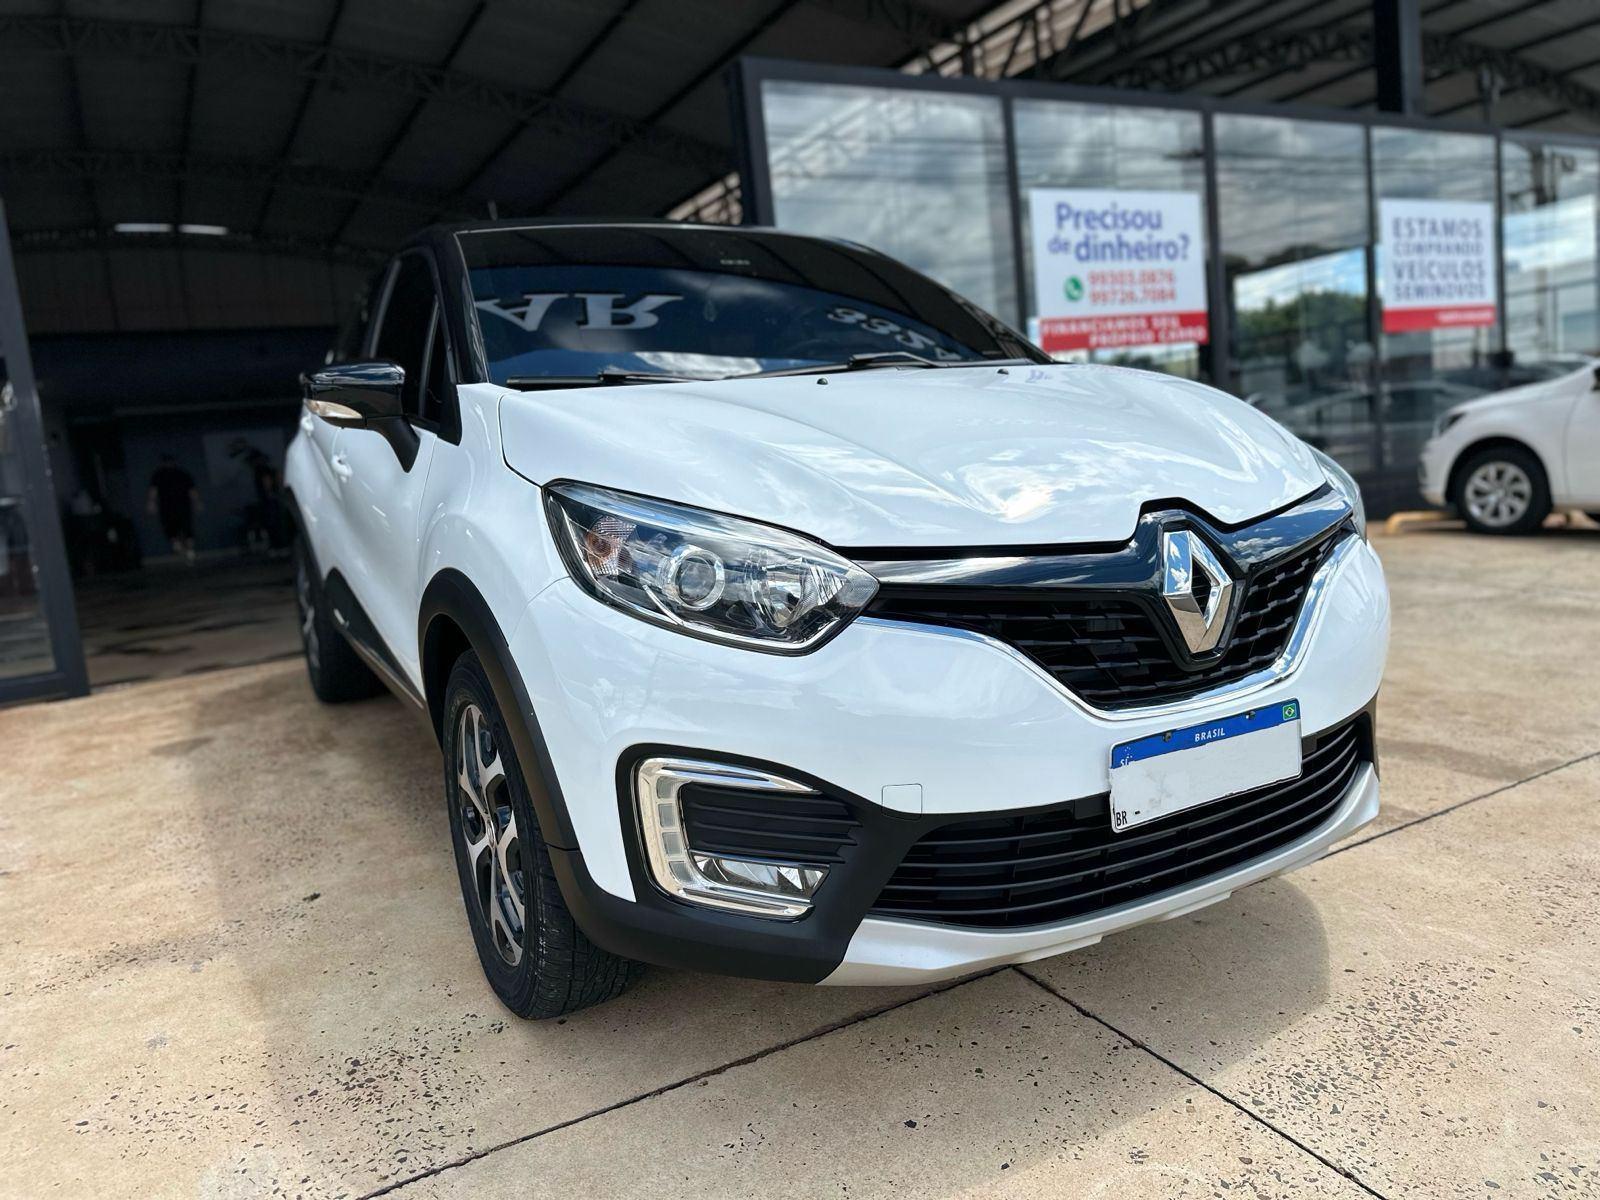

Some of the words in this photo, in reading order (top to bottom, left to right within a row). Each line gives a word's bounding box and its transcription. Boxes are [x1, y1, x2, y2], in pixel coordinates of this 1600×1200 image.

[1055, 201, 1163, 231] Precisou
[1392, 217, 1483, 238] ESTAMOS
[1047, 235, 1071, 254] de
[1075, 233, 1191, 263] dinheiro?
[1392, 242, 1484, 257] COMPRANDO
[1394, 283, 1486, 300] SEMINOVOS
[1157, 325, 1207, 343] CARRO
[1194, 727, 1226, 743] BRASIL
[1115, 810, 1128, 827] BR
